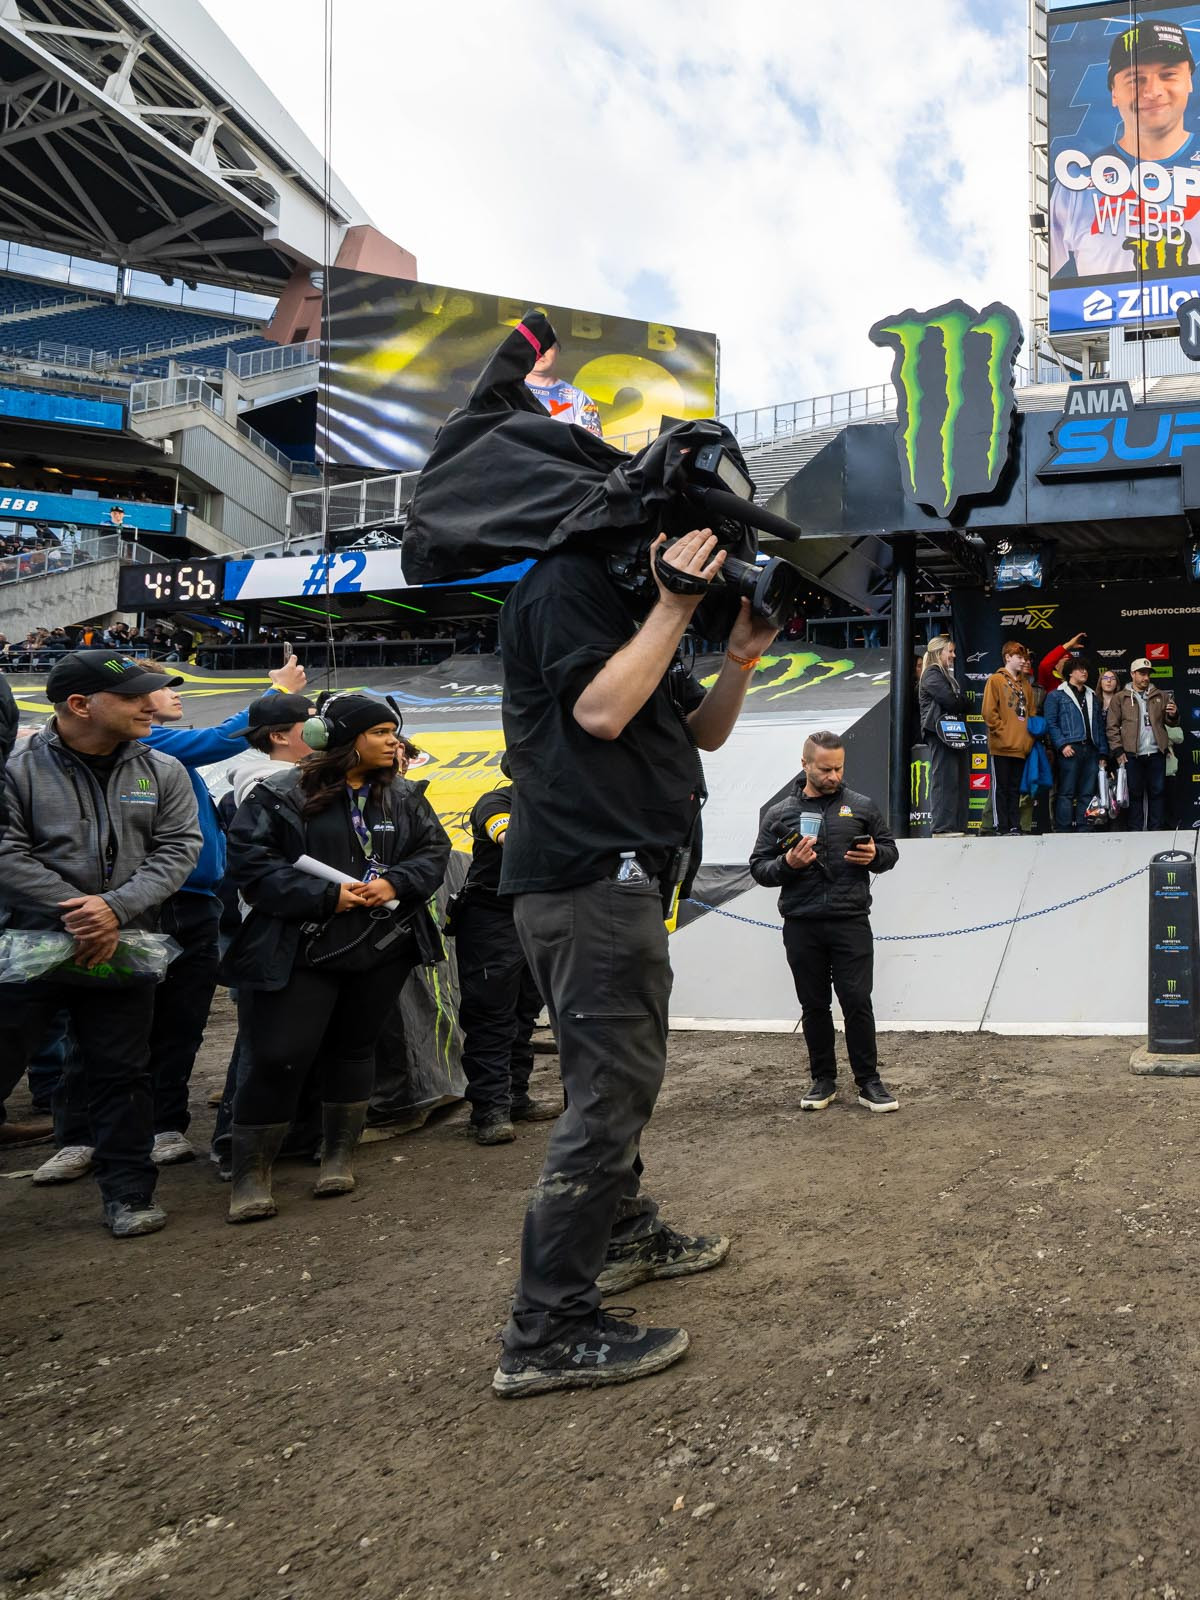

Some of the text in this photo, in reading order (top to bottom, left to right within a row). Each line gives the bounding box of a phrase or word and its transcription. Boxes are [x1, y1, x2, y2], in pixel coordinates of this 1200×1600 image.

[1093, 193, 1186, 245] WEBB
[1068, 388, 1129, 415] AMA
[0, 497, 39, 512] EBB
[144, 568, 216, 600] 4:56
[302, 551, 368, 596] #2
[1000, 608, 1054, 630] SMX
[909, 811, 933, 821] NSTE
